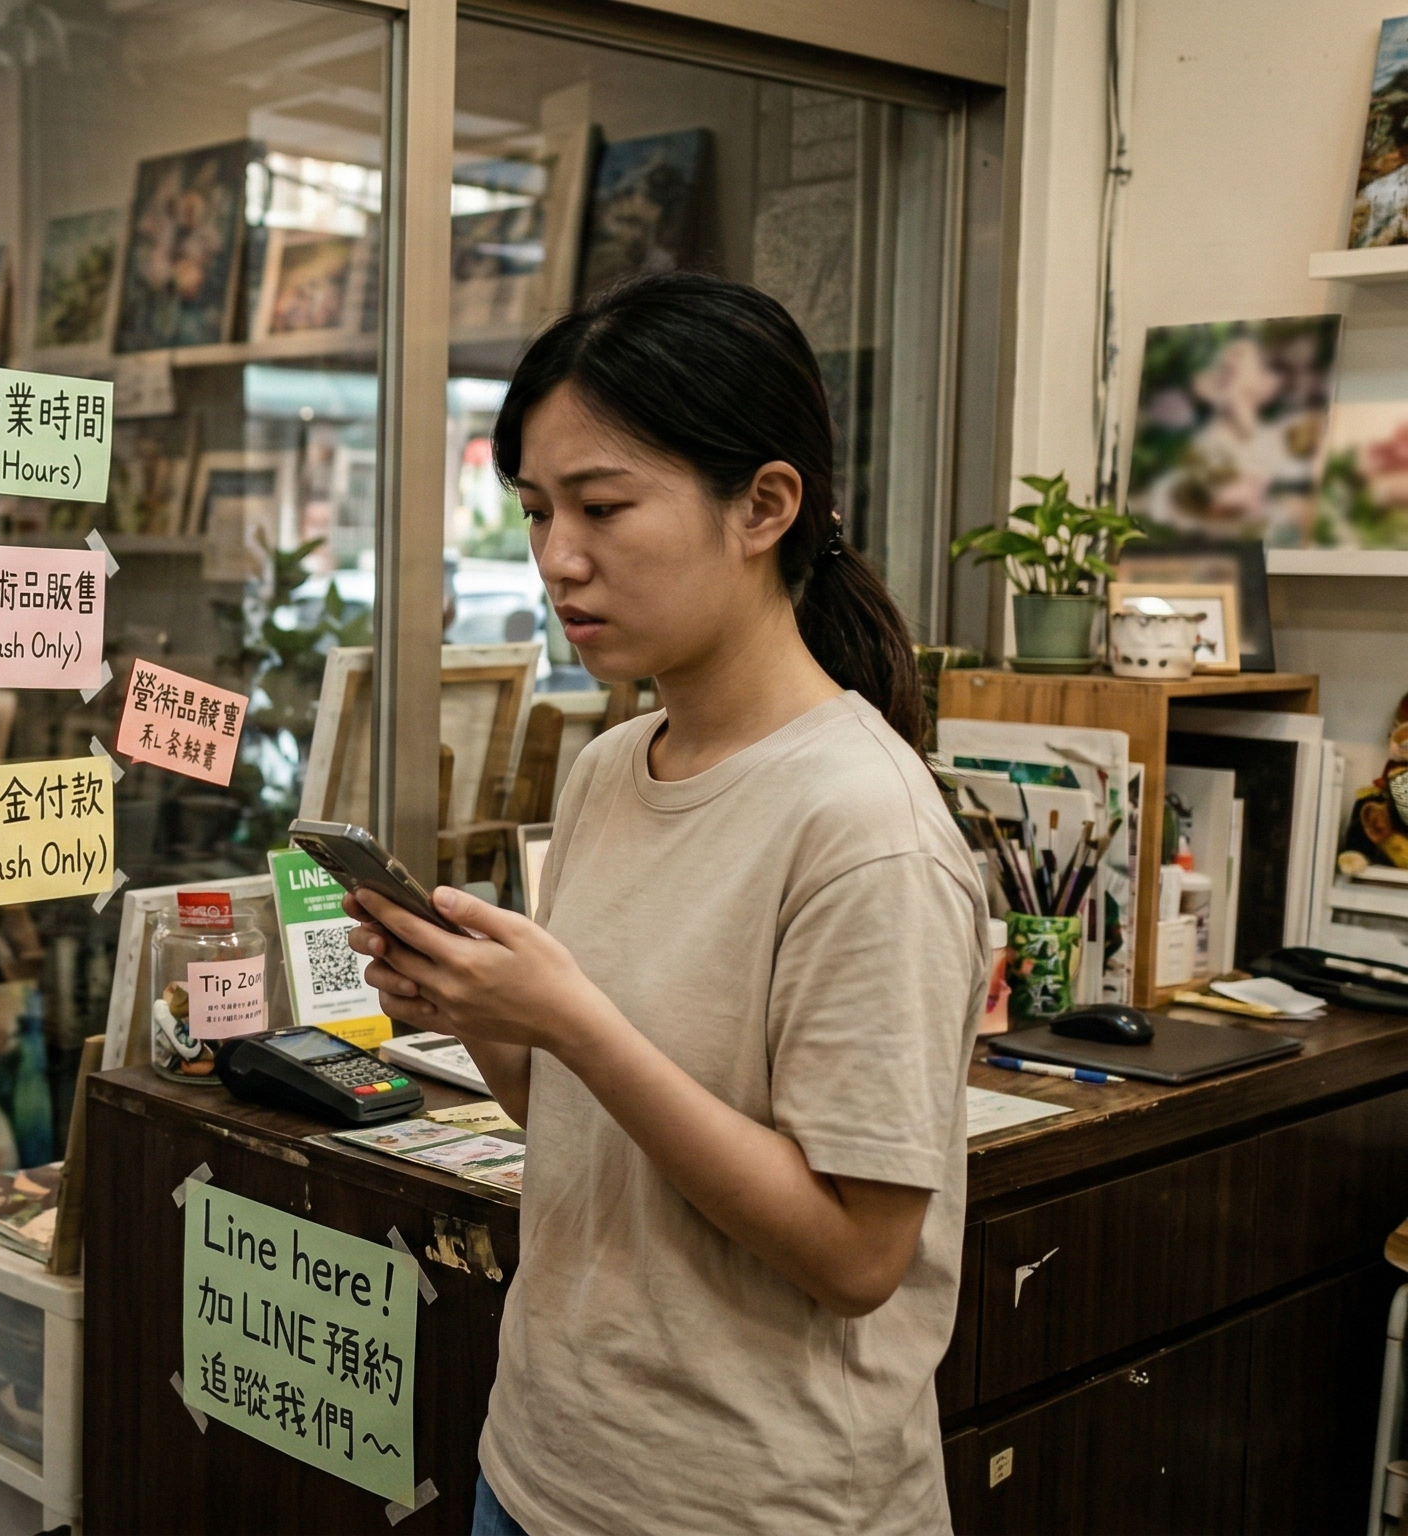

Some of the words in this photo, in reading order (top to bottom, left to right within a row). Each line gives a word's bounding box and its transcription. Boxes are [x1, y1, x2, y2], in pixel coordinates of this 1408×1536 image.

[31, 630, 82, 670] Only)
[41, 834, 108, 886] Only)
[288, 866, 338, 891] LINE
[198, 974, 232, 998] Tip
[203, 1197, 278, 1272] Line
[292, 1228, 395, 1317] here!
